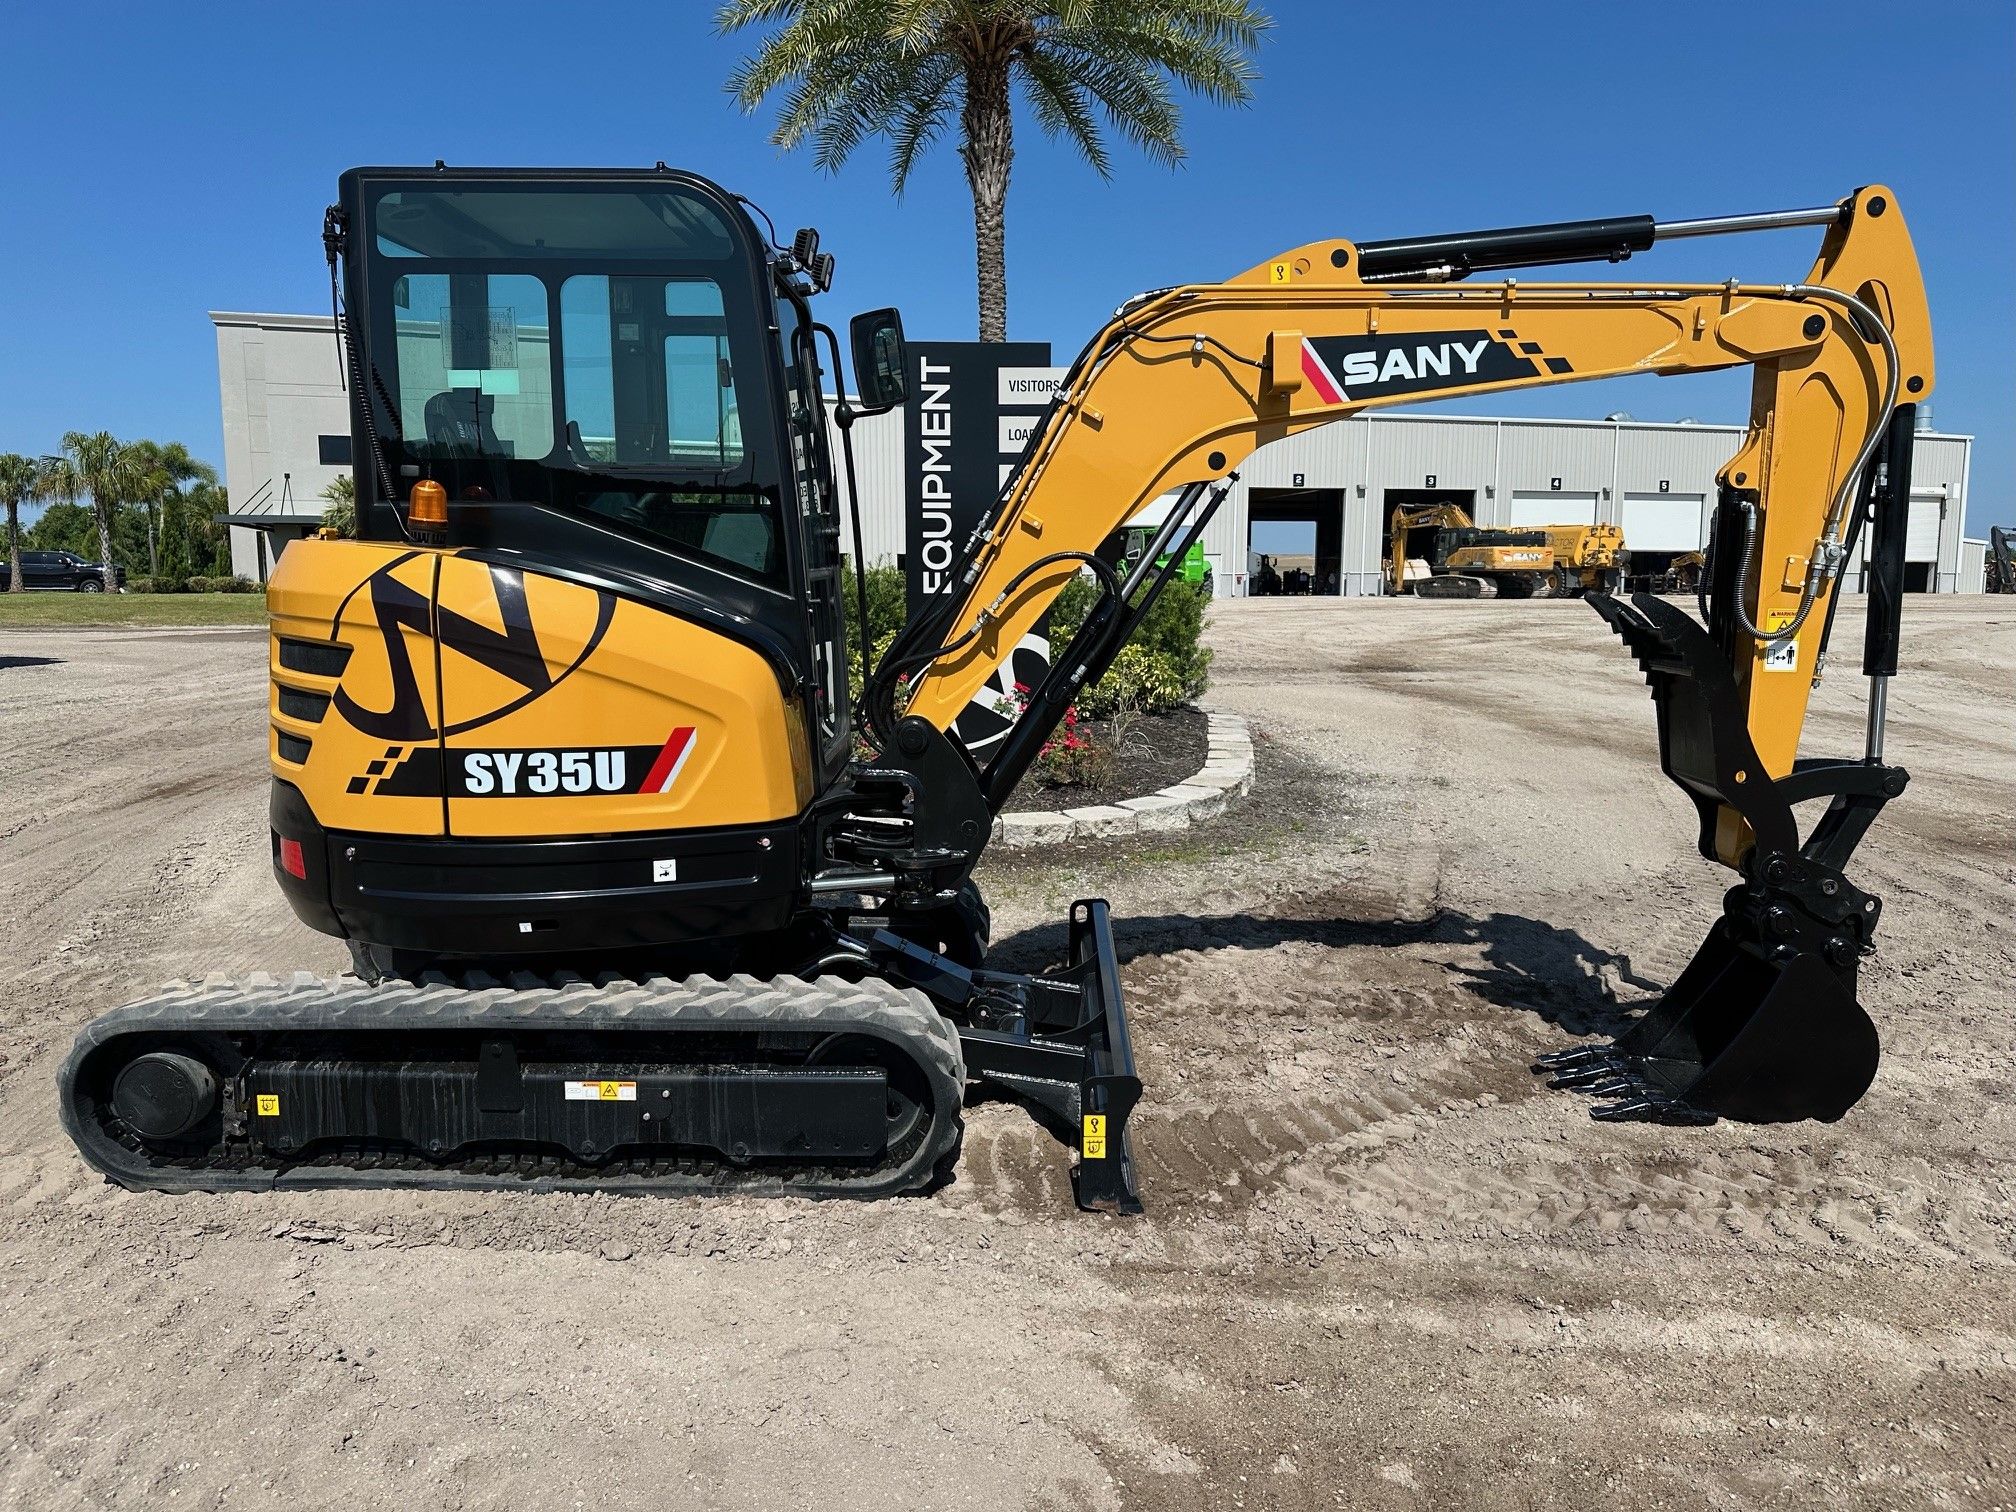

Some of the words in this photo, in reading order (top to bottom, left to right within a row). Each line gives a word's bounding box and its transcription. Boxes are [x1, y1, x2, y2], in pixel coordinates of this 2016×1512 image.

[1342, 340, 1490, 386] SANY
[1008, 380, 1060, 392] VISITORS
[920, 356, 953, 594] EQUIPMENT
[1553, 479, 1560, 487] 4
[1661, 481, 1668, 490] 5
[463, 750, 626, 794] SY35U
